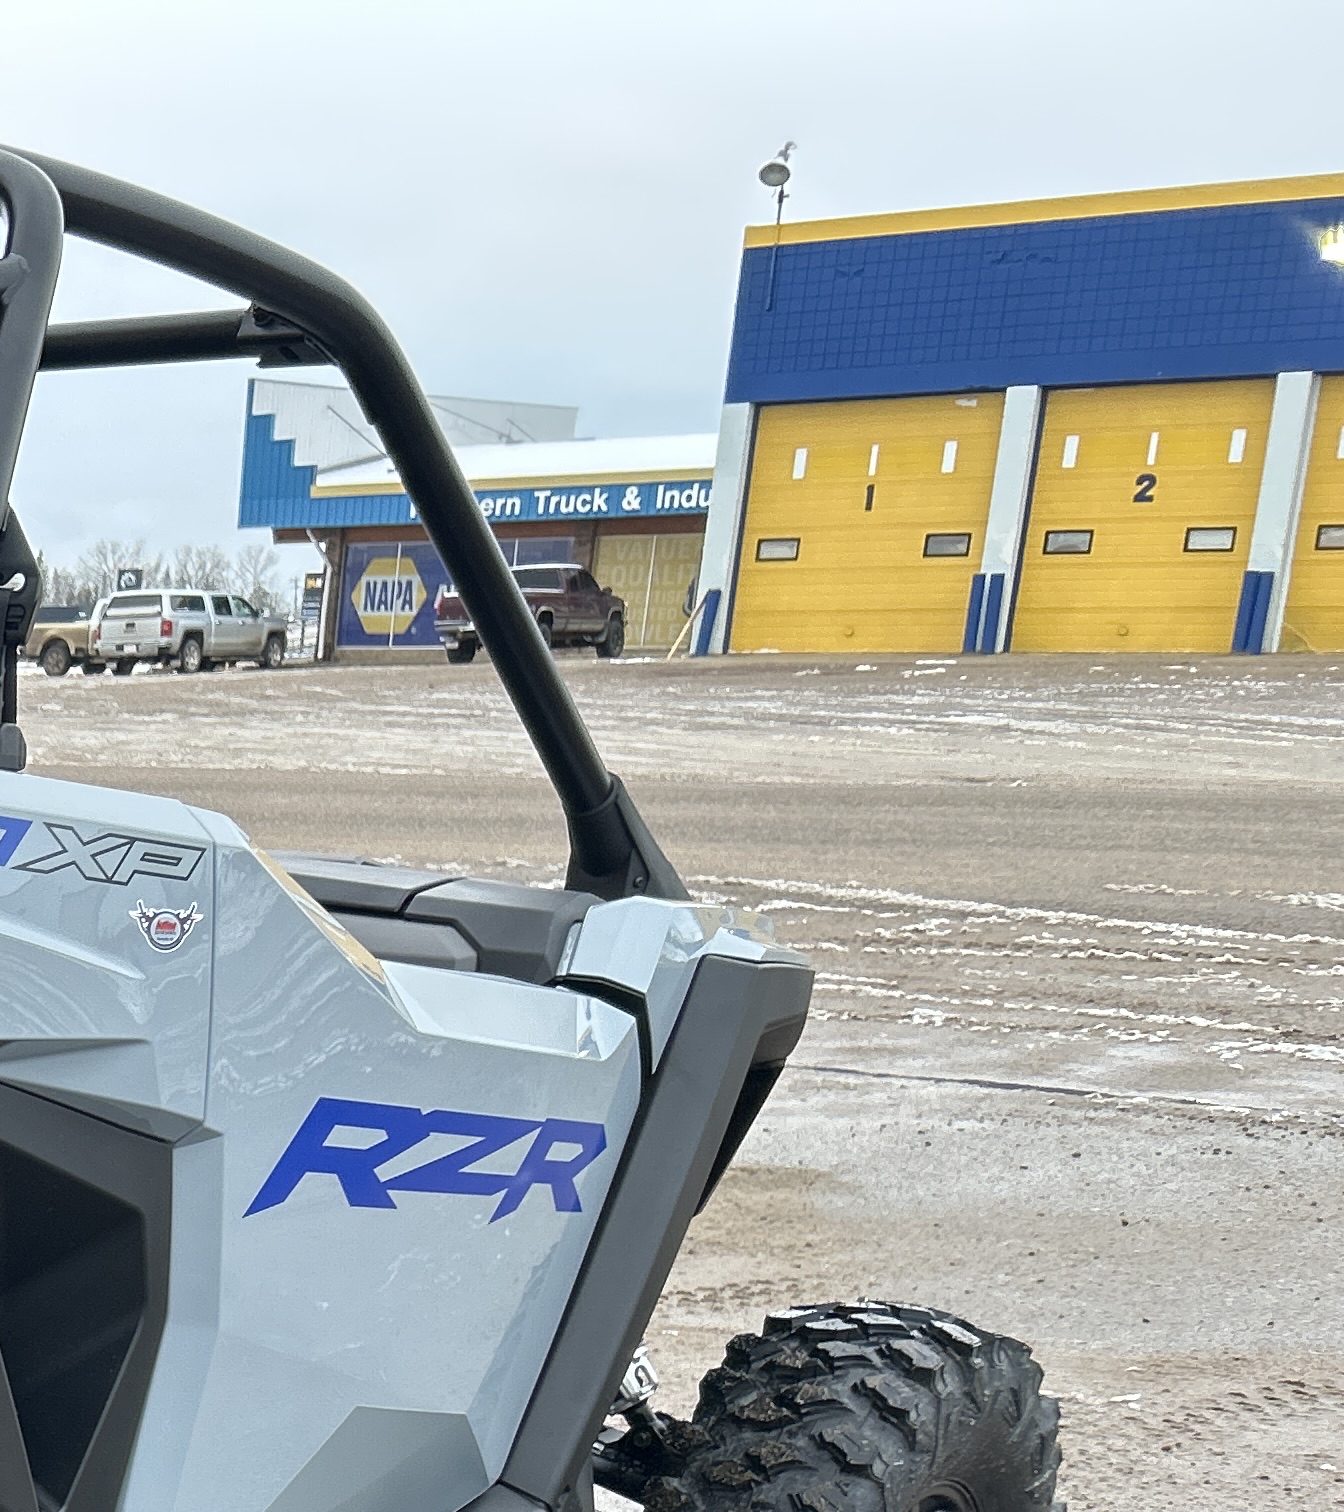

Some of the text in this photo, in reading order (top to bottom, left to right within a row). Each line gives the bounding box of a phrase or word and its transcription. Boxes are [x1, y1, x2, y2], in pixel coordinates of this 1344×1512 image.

[533, 487, 609, 515] Truck
[621, 486, 641, 511] &
[864, 484, 875, 511] 1
[1132, 473, 1158, 503] 2
[363, 579, 414, 612] NAPA
[12, 822, 206, 885] XP
[242, 1096, 606, 1224] RZR
